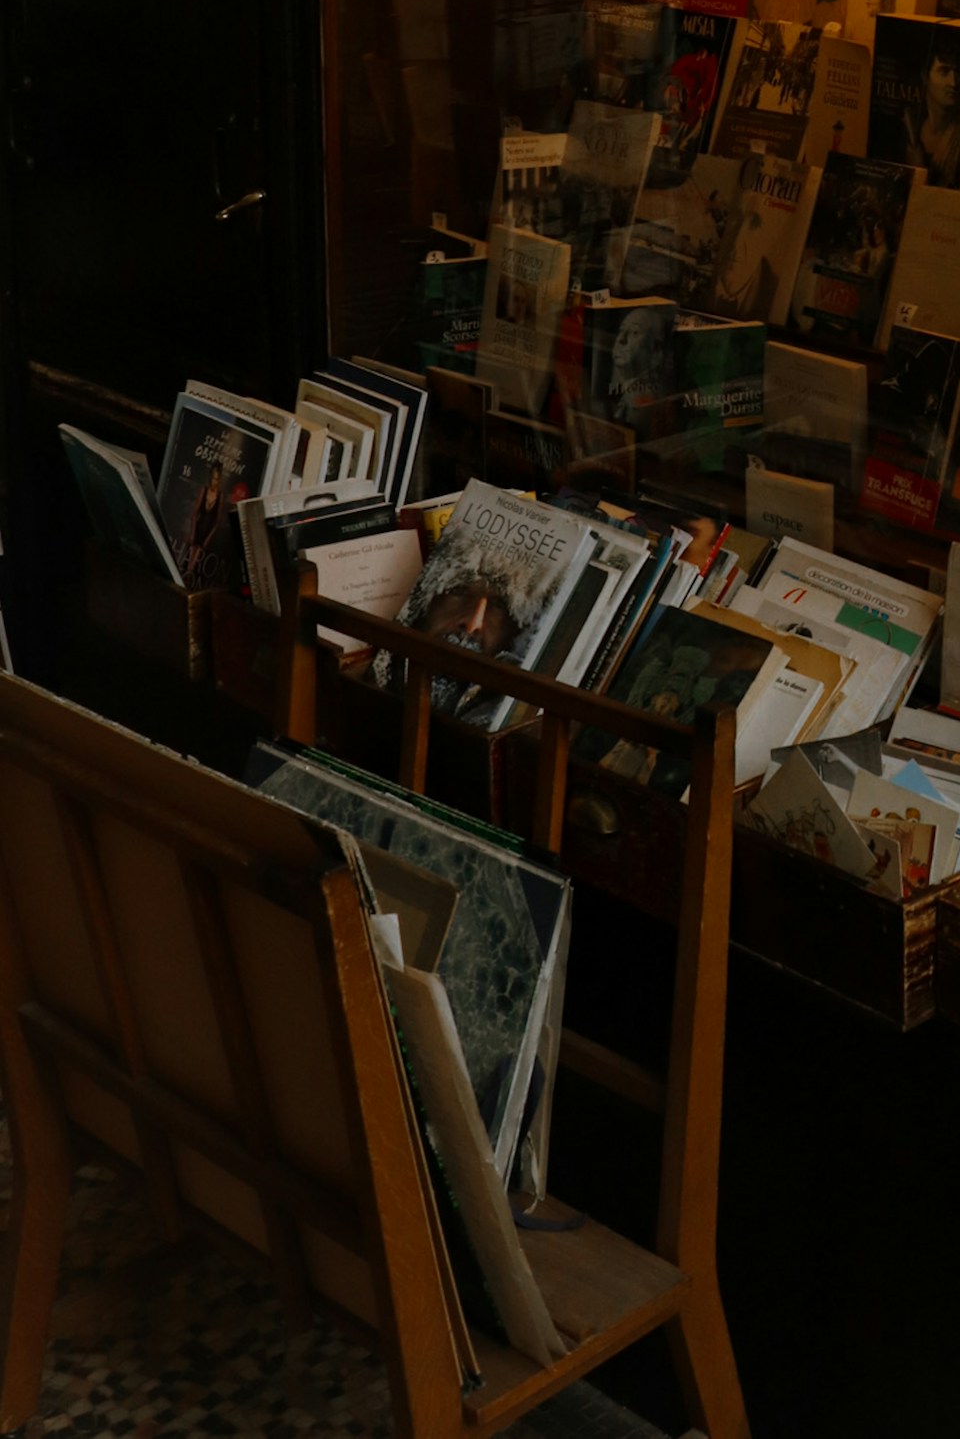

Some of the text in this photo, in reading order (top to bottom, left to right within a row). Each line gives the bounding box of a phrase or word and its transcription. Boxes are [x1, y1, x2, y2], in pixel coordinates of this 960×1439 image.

[874, 79, 922, 104] TALMA
[682, 387, 763, 411] Marguerite
[719, 401, 763, 420] Duras
[495, 495, 523, 517] Nicolas
[867, 478, 934, 512] TRANSFUGE
[461, 500, 568, 563] L'ODYSSÉE
[761, 508, 804, 533] espace
[168, 534, 233, 580] HARON
[807, 568, 853, 594] décoration
[852, 587, 865, 600] de
[870, 595, 905, 616] maison
